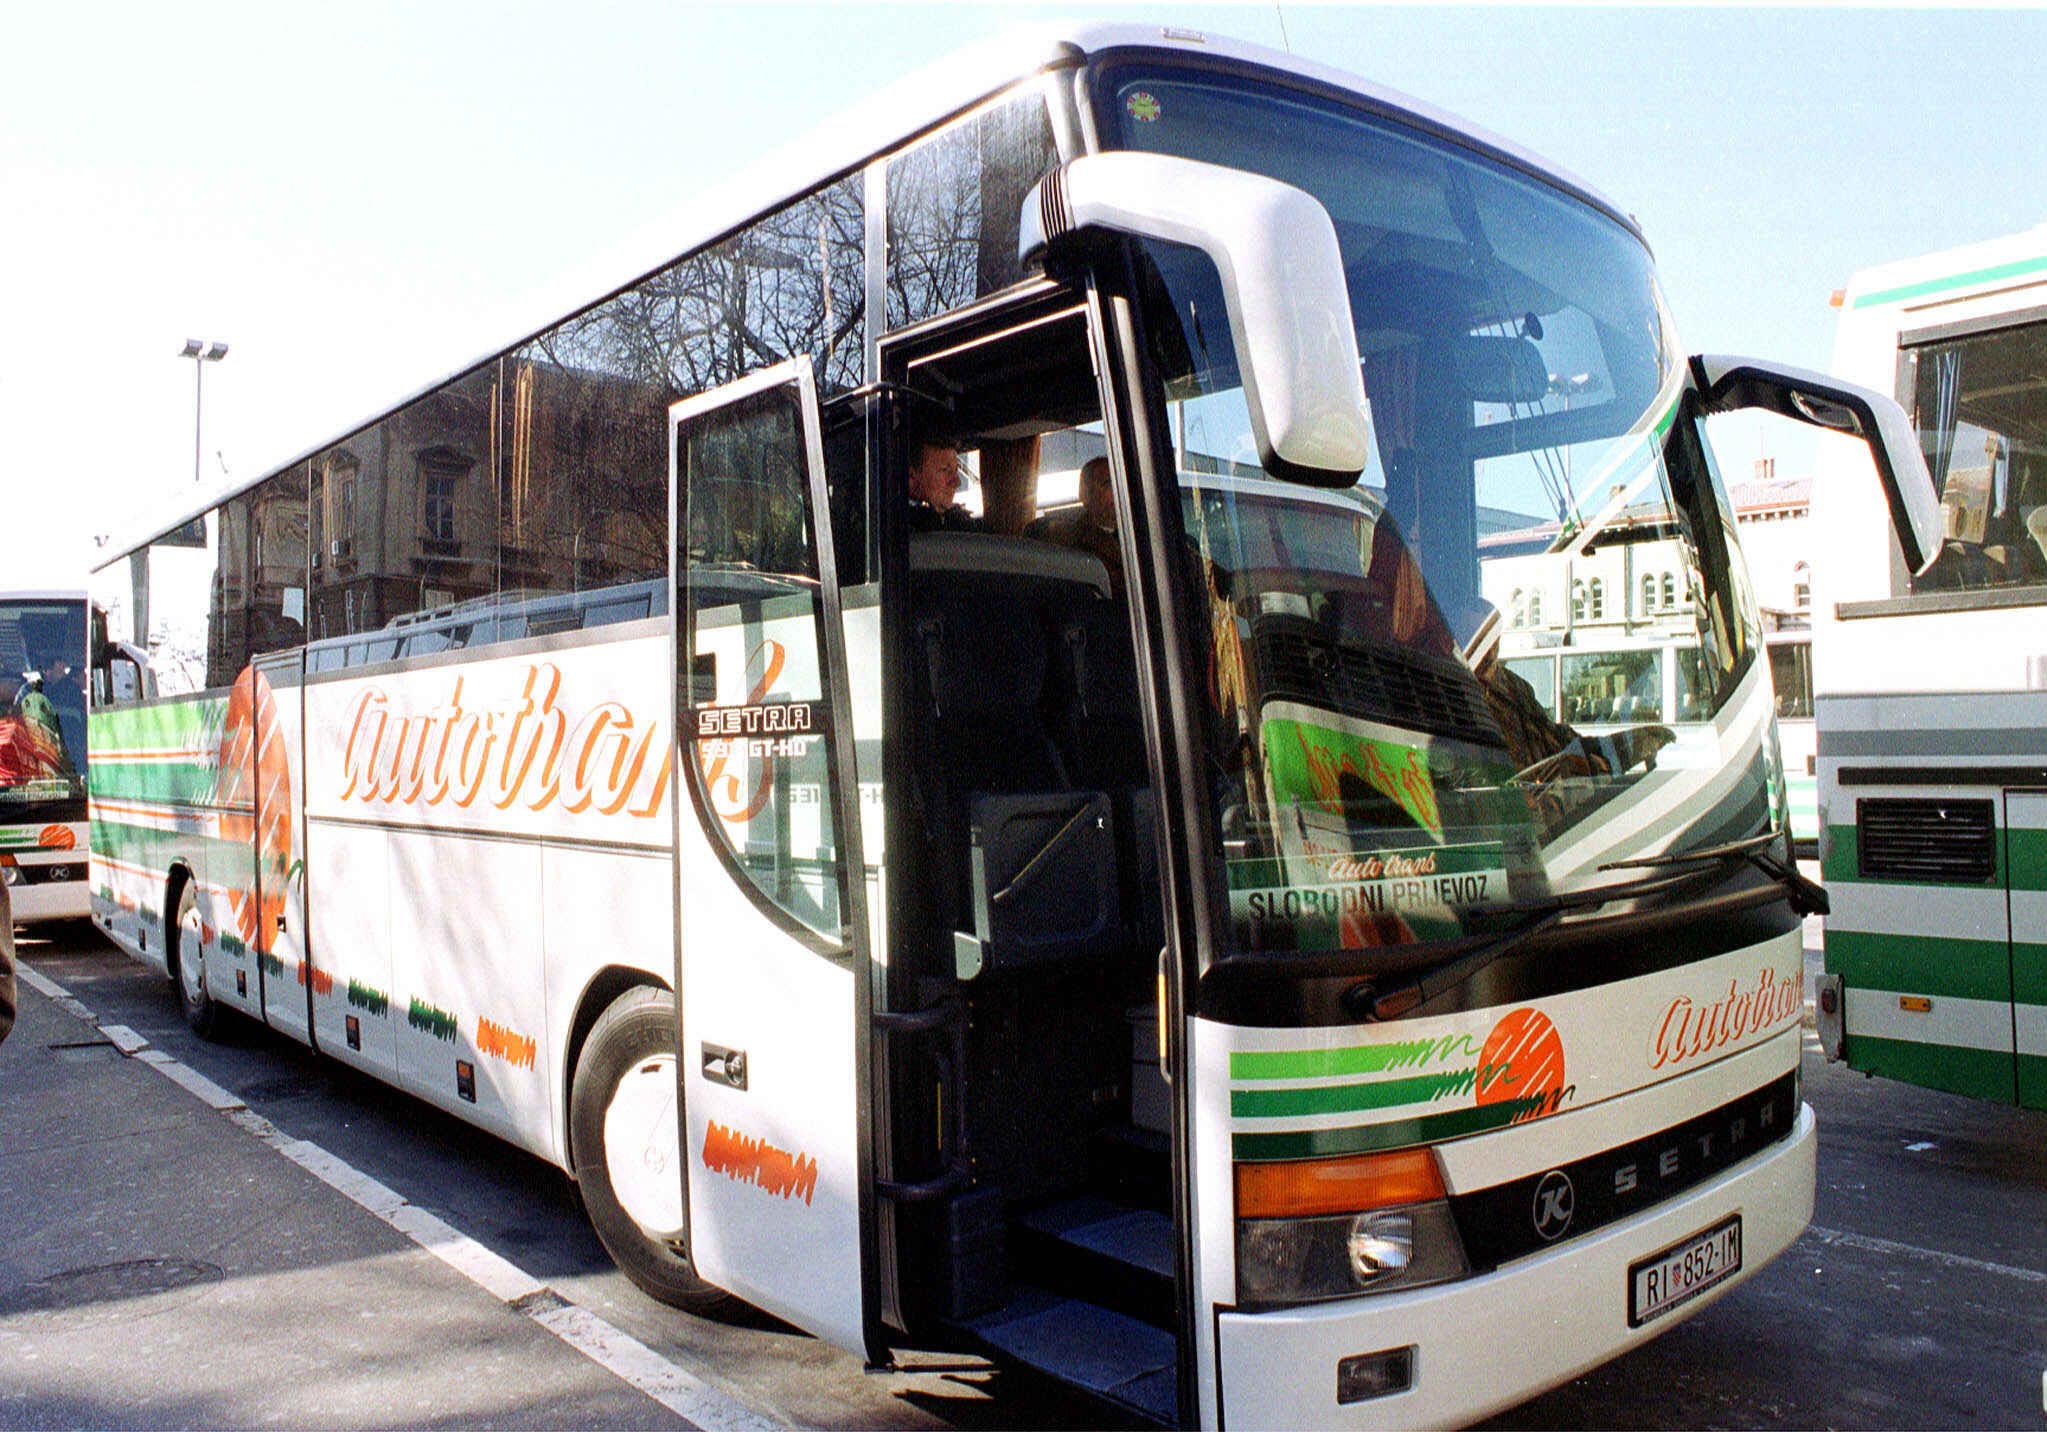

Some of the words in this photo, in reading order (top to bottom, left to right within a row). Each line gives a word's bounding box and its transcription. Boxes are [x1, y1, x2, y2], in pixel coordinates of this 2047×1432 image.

[698, 703, 811, 735] SETRA
[749, 738, 806, 758] GT-HD
[1249, 883, 1385, 920] SLOBODNI
[1391, 875, 1489, 909] PRIJEVOZ
[1614, 1102, 1775, 1195] SETRA
[1647, 1263, 1668, 1307] RI
[1683, 1226, 1738, 1287] 852-IM
